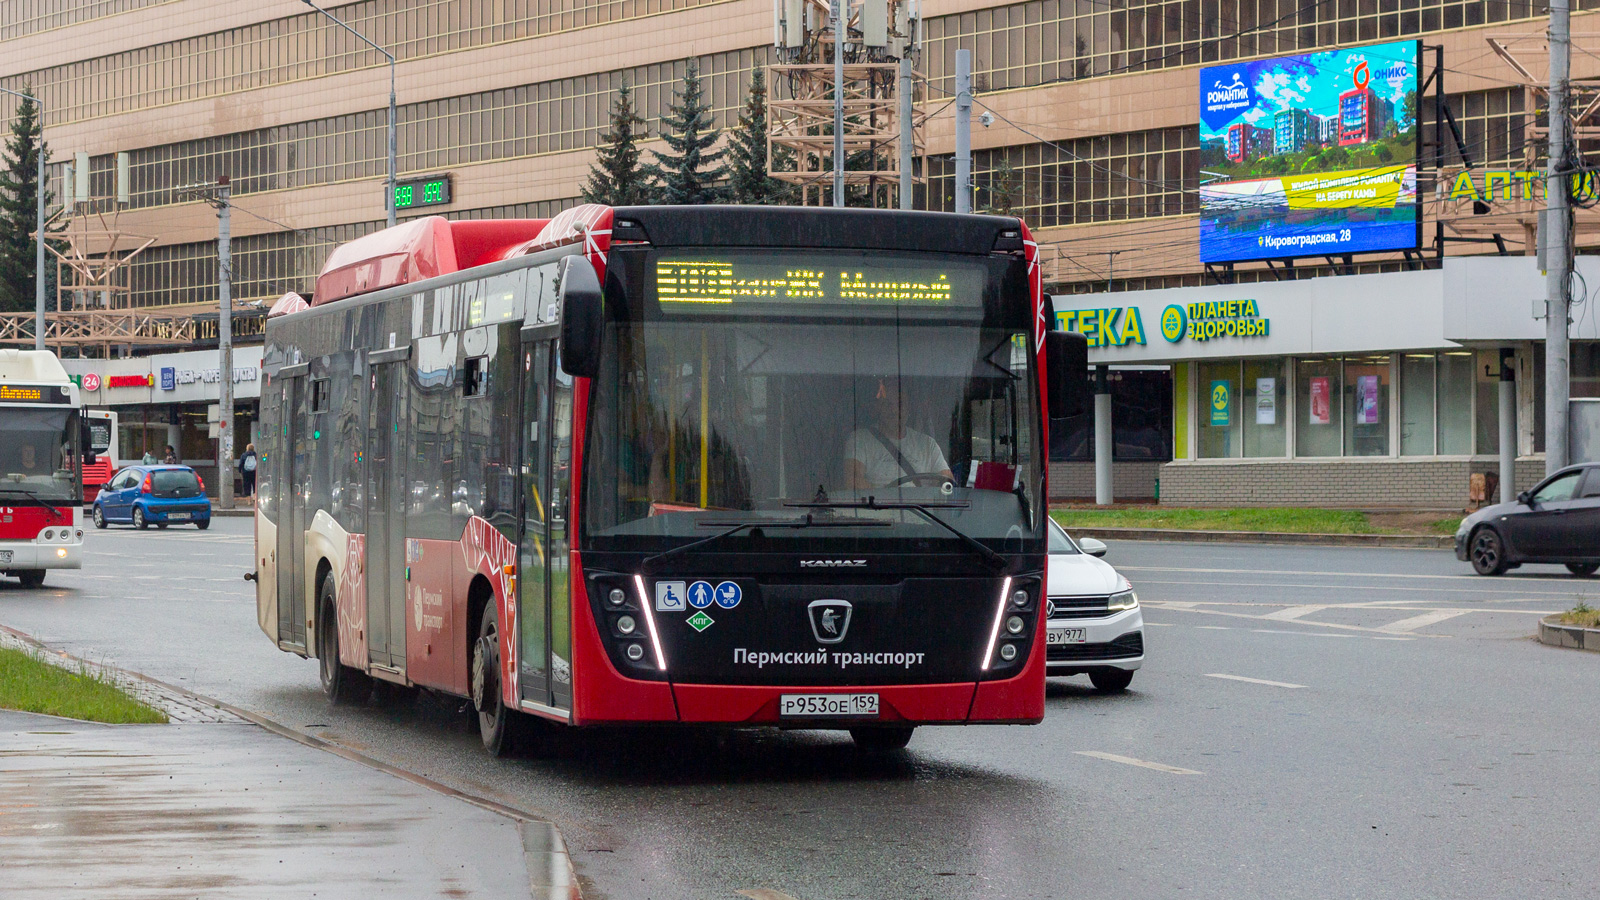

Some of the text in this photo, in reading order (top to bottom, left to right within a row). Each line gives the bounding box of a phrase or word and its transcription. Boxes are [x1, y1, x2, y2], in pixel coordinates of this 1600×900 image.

[1374, 66, 1407, 79] ОНИКС
[1207, 87, 1249, 103] РОМАНТИК
[1291, 178, 1319, 191] ЖИЛОЙ
[1319, 176, 1359, 189] КОМПЛЕКС
[1315, 188, 1377, 202] НА БЕРЕГУ КАМЫ
[1265, 229, 1352, 250] Кировоградская, 28
[1187, 299, 1258, 319] ПЛАНЕТА
[1187, 319, 1269, 341] ЗДОРОВЬЯ
[85, 377, 97, 387] 24
[1214, 391, 1227, 403] 24
[800, 559, 867, 567] KAMAZ
[692, 617, 709, 626] КПГ
[1065, 629, 1083, 639] 977
[734, 647, 925, 668] Пермский транспорт
[852, 696, 875, 709] 159
